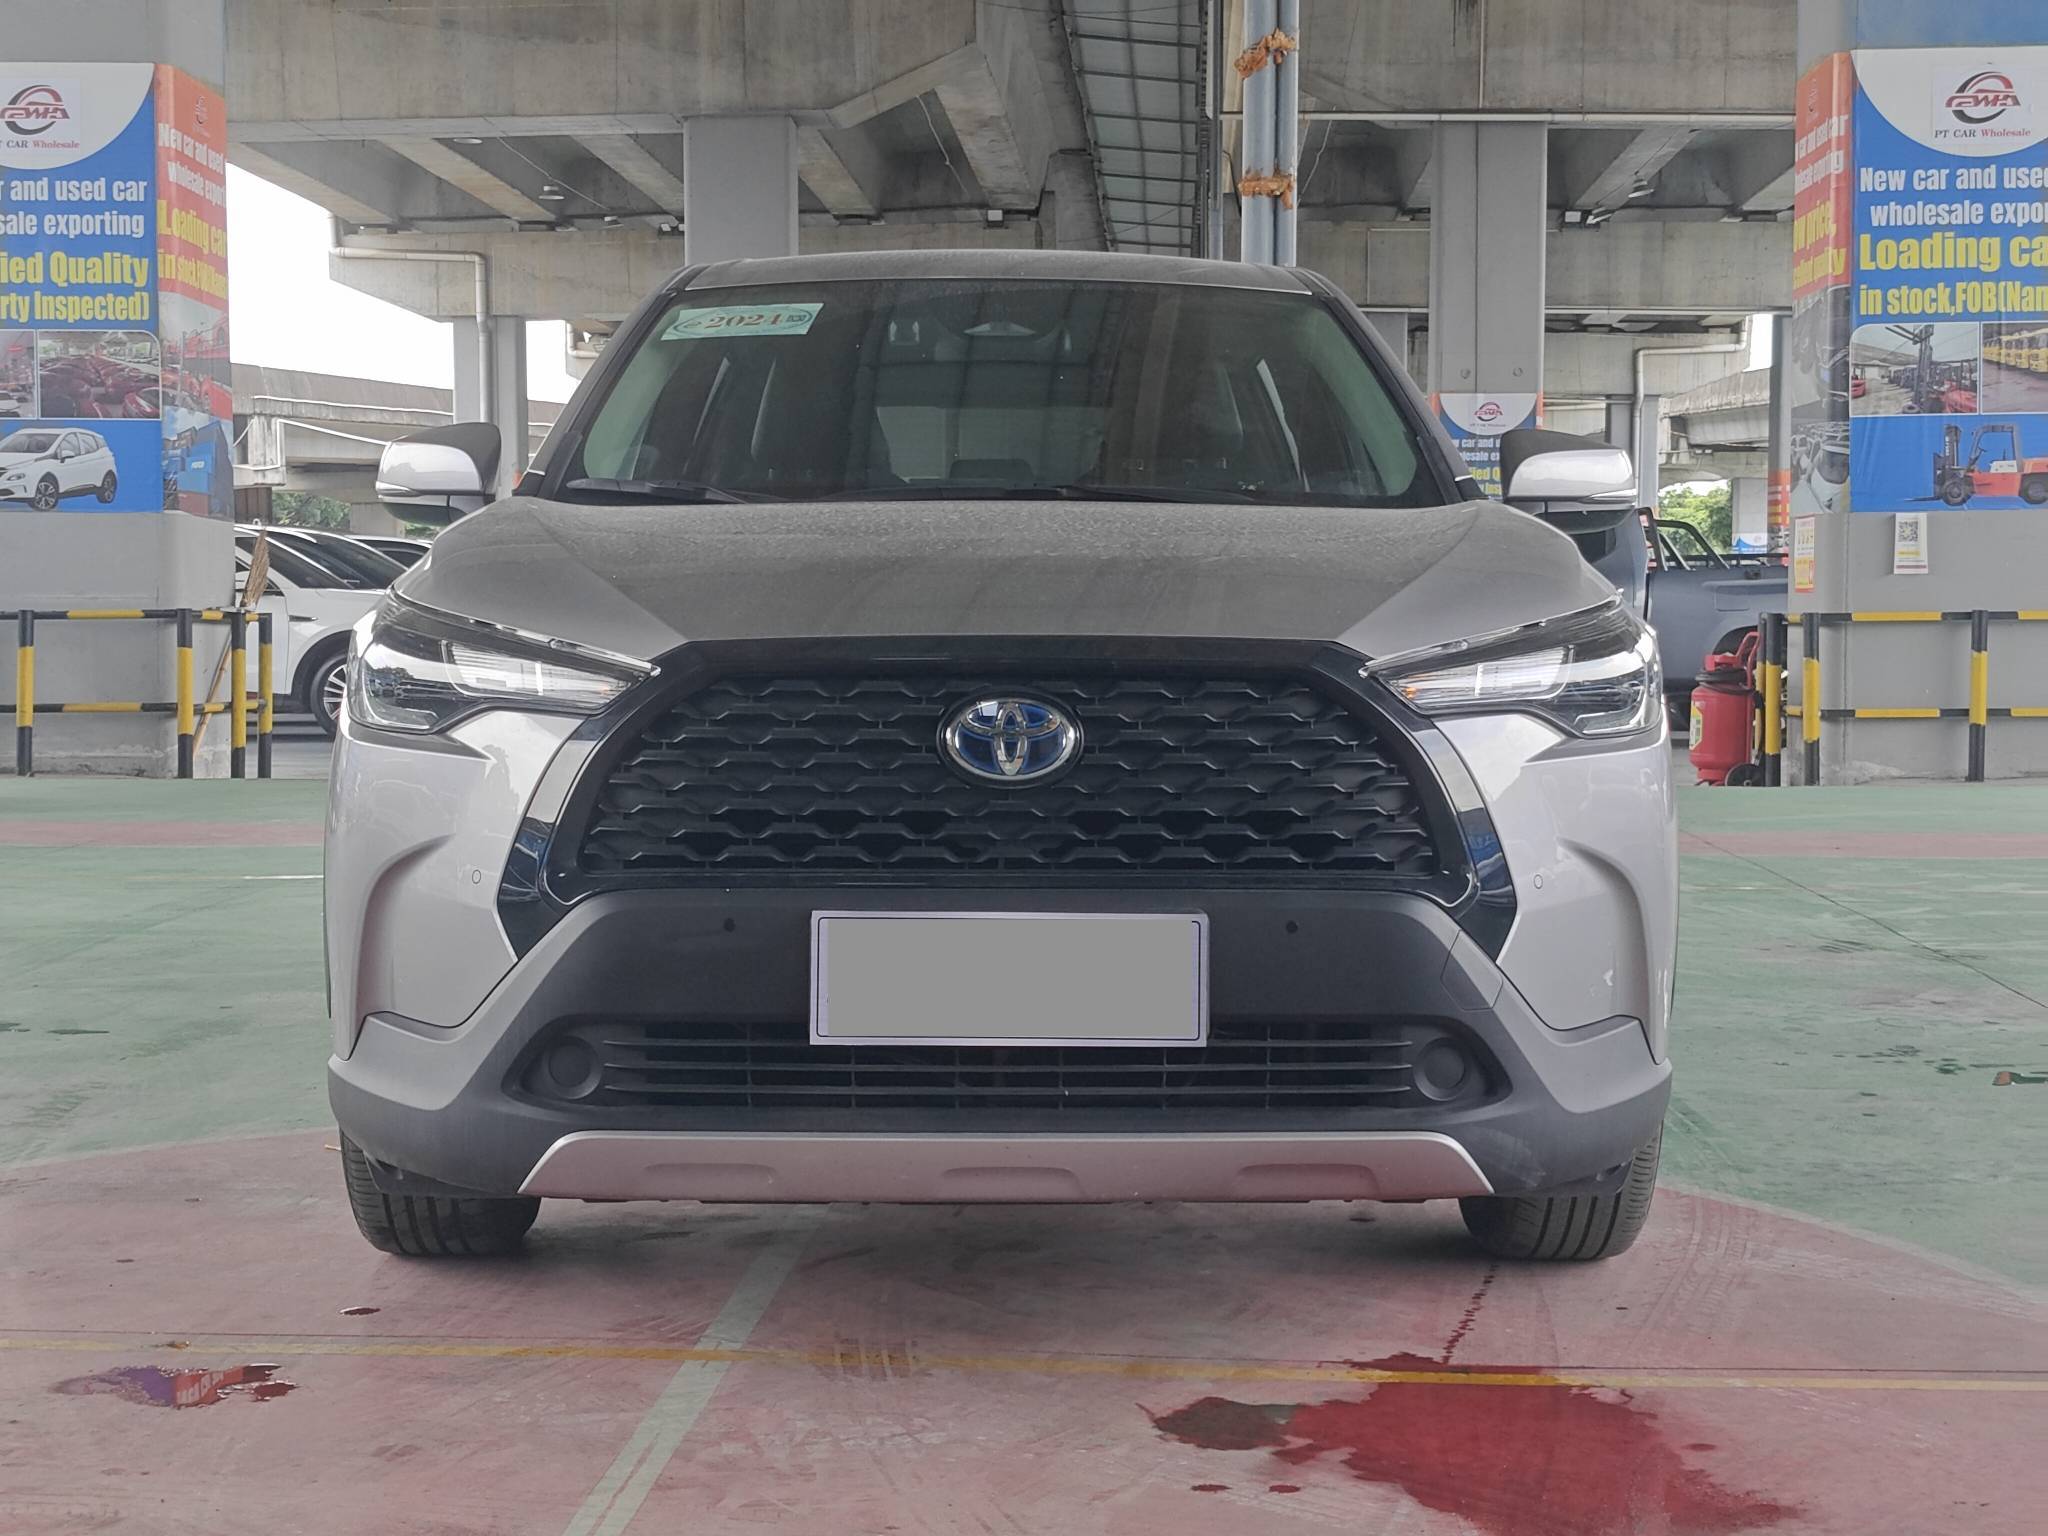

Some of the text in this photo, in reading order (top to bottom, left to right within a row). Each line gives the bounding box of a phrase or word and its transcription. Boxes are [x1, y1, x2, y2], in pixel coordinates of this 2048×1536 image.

[6, 140, 29, 149] CAR
[32, 140, 80, 149] Wholesale
[1934, 129, 2031, 138] PT CAR Wholesale
[10, 177, 49, 201] and
[55, 178, 106, 201] used
[112, 180, 148, 201] car
[1860, 167, 1905, 192] New
[1913, 169, 1949, 190] car
[1956, 164, 1997, 189] and
[44, 212, 144, 239] exporting
[1871, 200, 1983, 227] wholesale
[1860, 232, 2001, 272] Loading
[50, 251, 149, 288] Quality
[1860, 284, 1882, 315] in
